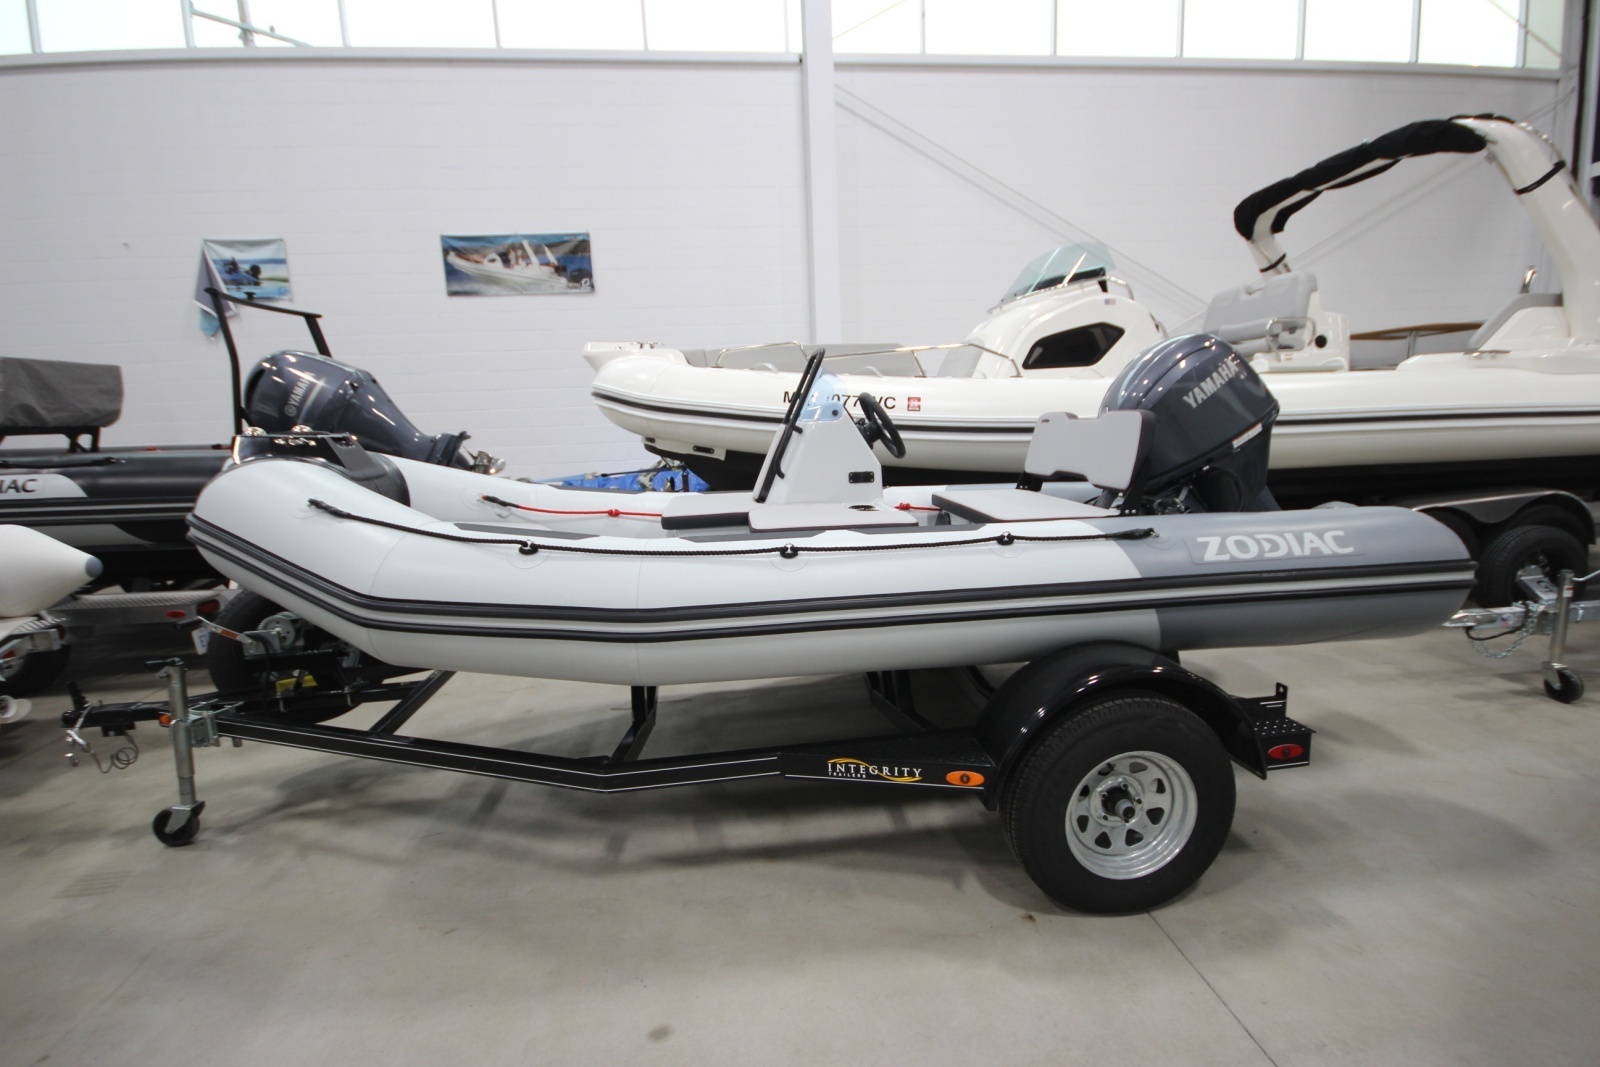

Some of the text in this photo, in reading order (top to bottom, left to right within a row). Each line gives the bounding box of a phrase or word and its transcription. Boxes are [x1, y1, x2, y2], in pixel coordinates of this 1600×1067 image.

[1182, 359, 1239, 408] YAMAHA
[827, 394, 861, 408] 077
[1196, 530, 1355, 561] ZODIAC
[828, 763, 922, 777] INTEGRITY
